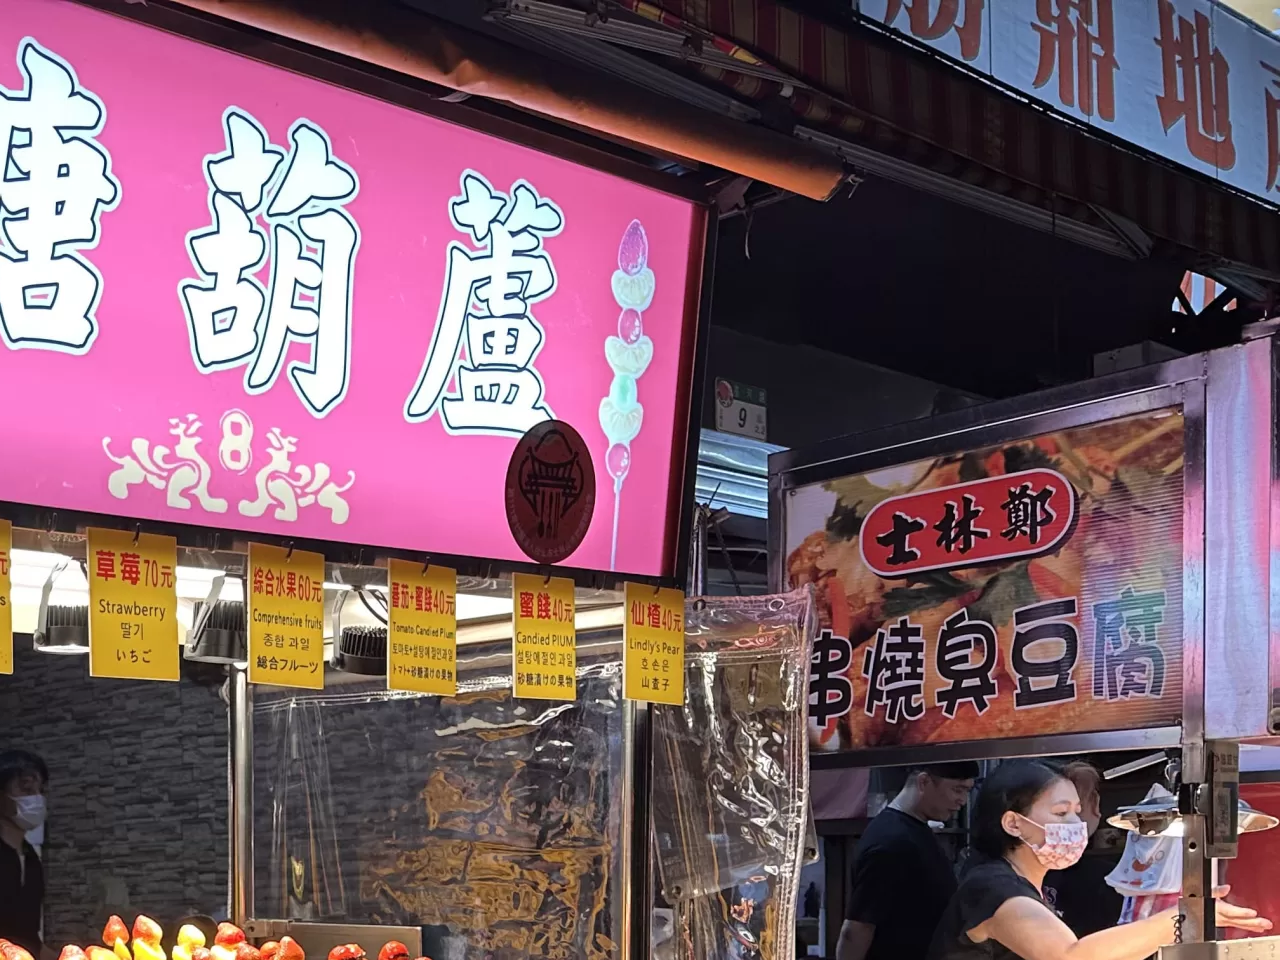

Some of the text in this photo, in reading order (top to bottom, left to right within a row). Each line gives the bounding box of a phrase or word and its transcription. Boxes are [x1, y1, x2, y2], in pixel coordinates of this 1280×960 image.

[738, 407, 747, 428] 9
[876, 482, 1058, 566] 士林鄭
[253, 567, 322, 603] 綜合水果60元
[99, 599, 166, 621] Strawberry
[253, 608, 322, 630] Comprehensive fruits
[120, 622, 144, 640] 딸기
[393, 621, 414, 634] Tomato
[263, 633, 310, 651] 종합 과일
[517, 631, 550, 646] Candied
[116, 648, 152, 664] いちご
[662, 643, 680, 655] Pear
[809, 585, 1168, 728] 串燒臭豆腐
